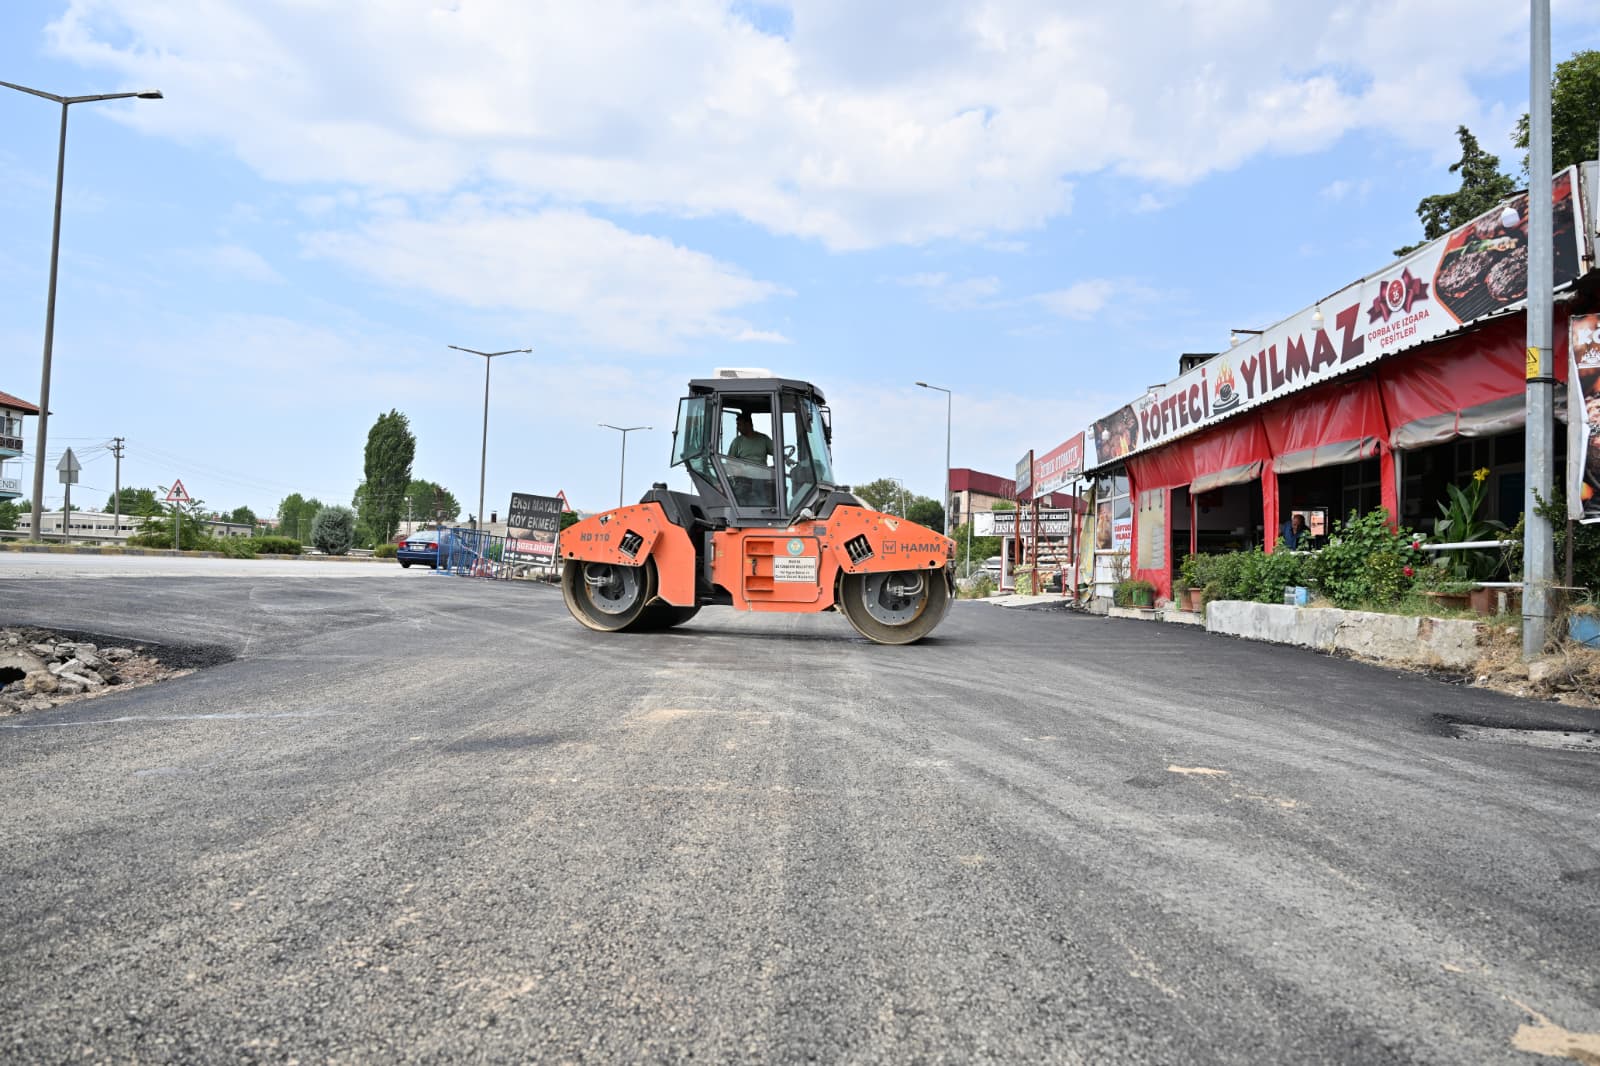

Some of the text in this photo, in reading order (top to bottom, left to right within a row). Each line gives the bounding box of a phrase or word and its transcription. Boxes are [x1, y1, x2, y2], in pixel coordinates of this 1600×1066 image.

[1367, 309, 1430, 343] ÇORBA VE IZGARA
[1380, 324, 1417, 348] ÇEŞİTLERİ
[1140, 302, 1365, 443] KÖFTECİ YILMAZ
[532, 500, 560, 514] MAYALI
[509, 512, 527, 527] KÖY
[581, 532, 609, 541] HD 110
[900, 543, 941, 553] HAMM
